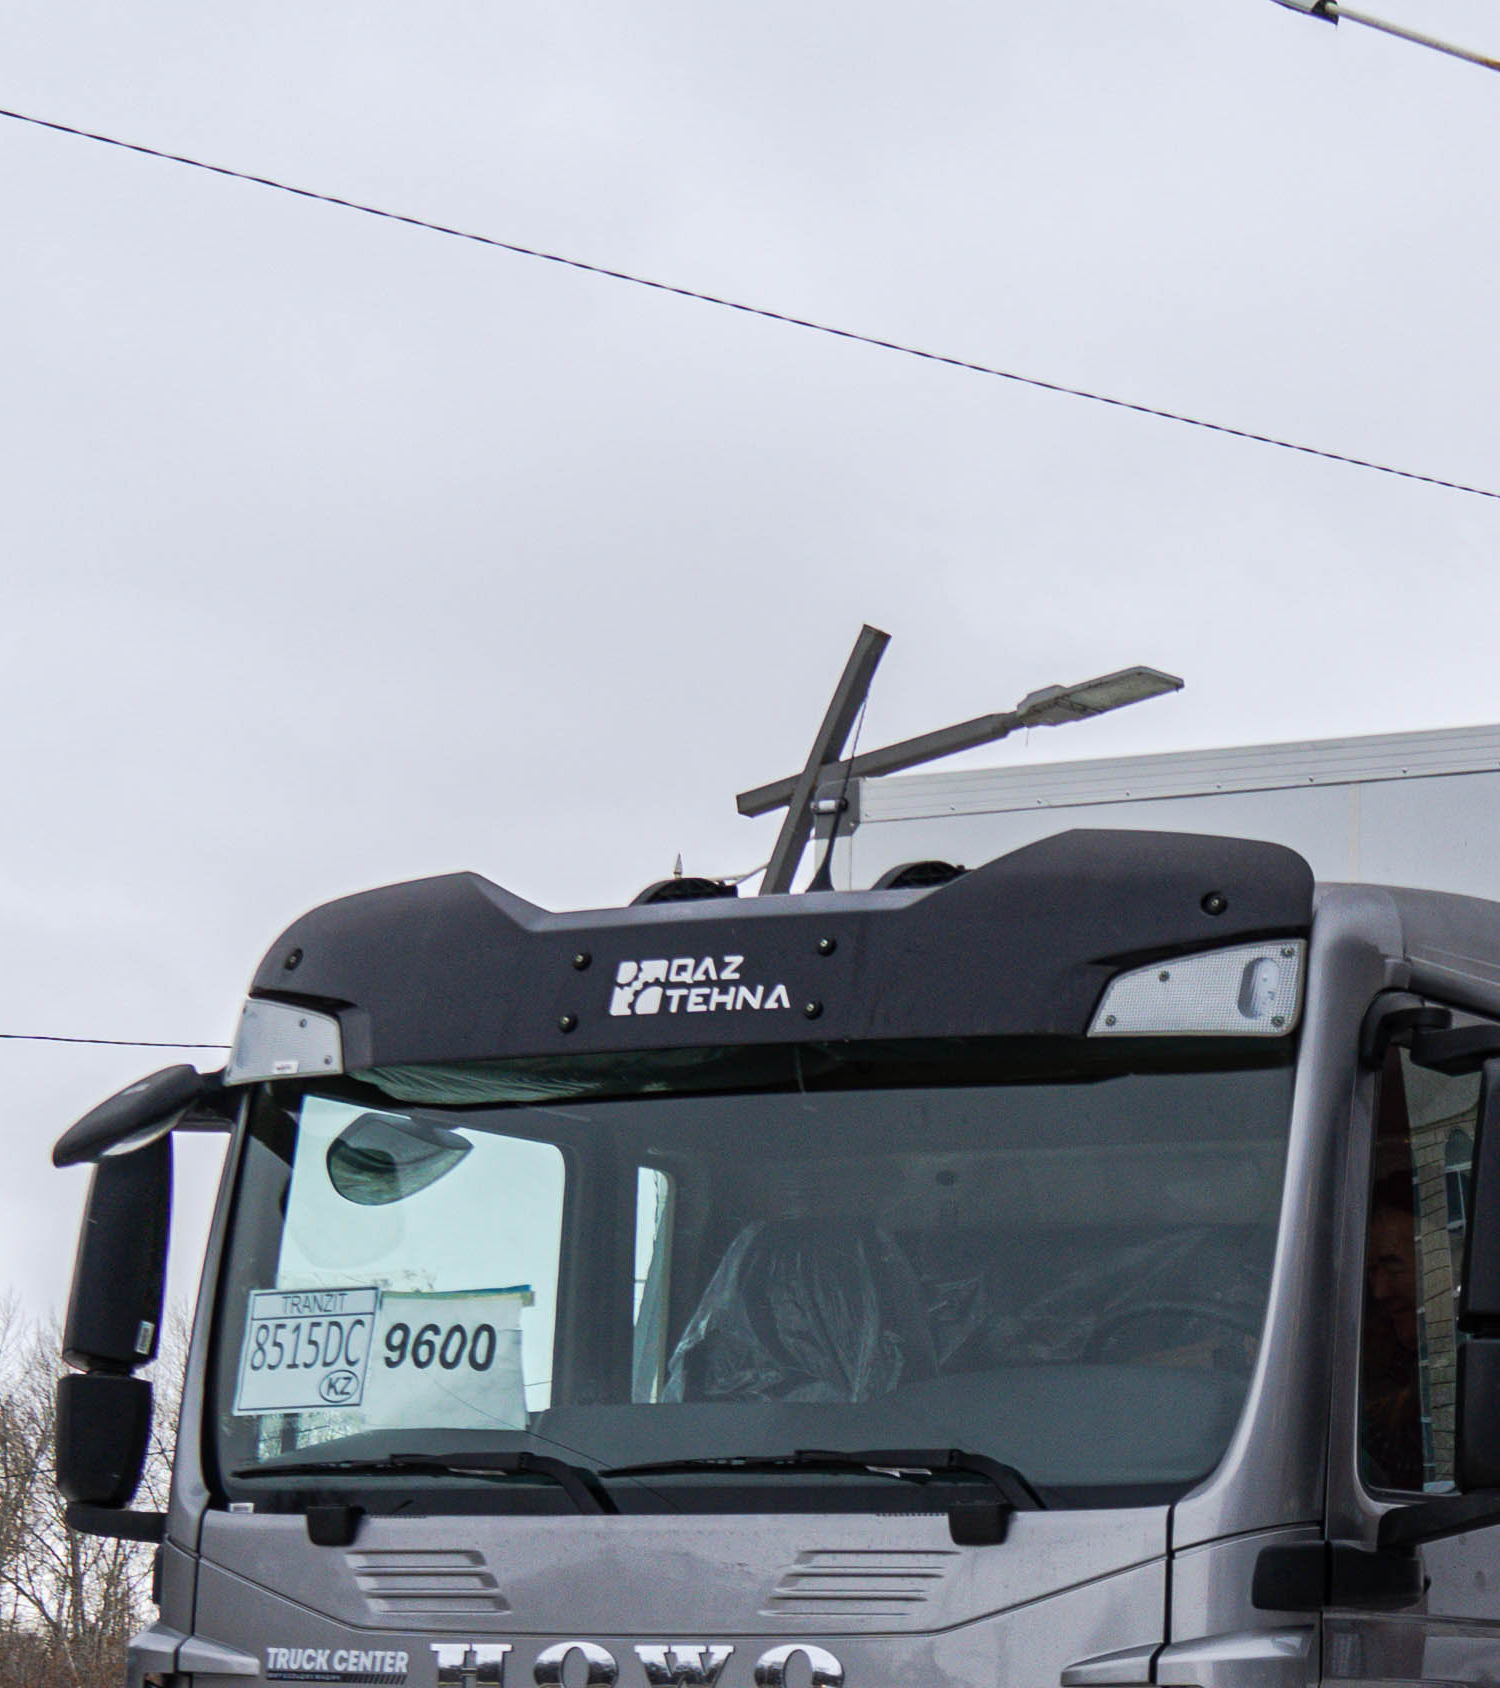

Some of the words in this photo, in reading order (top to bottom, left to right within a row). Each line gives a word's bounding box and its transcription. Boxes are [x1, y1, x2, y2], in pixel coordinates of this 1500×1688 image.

[669, 955, 744, 984] QAZ
[666, 984, 790, 1013] TEHNA
[281, 1293, 348, 1314] TRANZIT
[250, 1319, 366, 1372] 8515DC
[384, 1322, 497, 1372] 9600
[326, 1376, 352, 1397] KZ
[267, 1647, 331, 1671] TRUCK
[333, 1650, 409, 1673] CENTER
